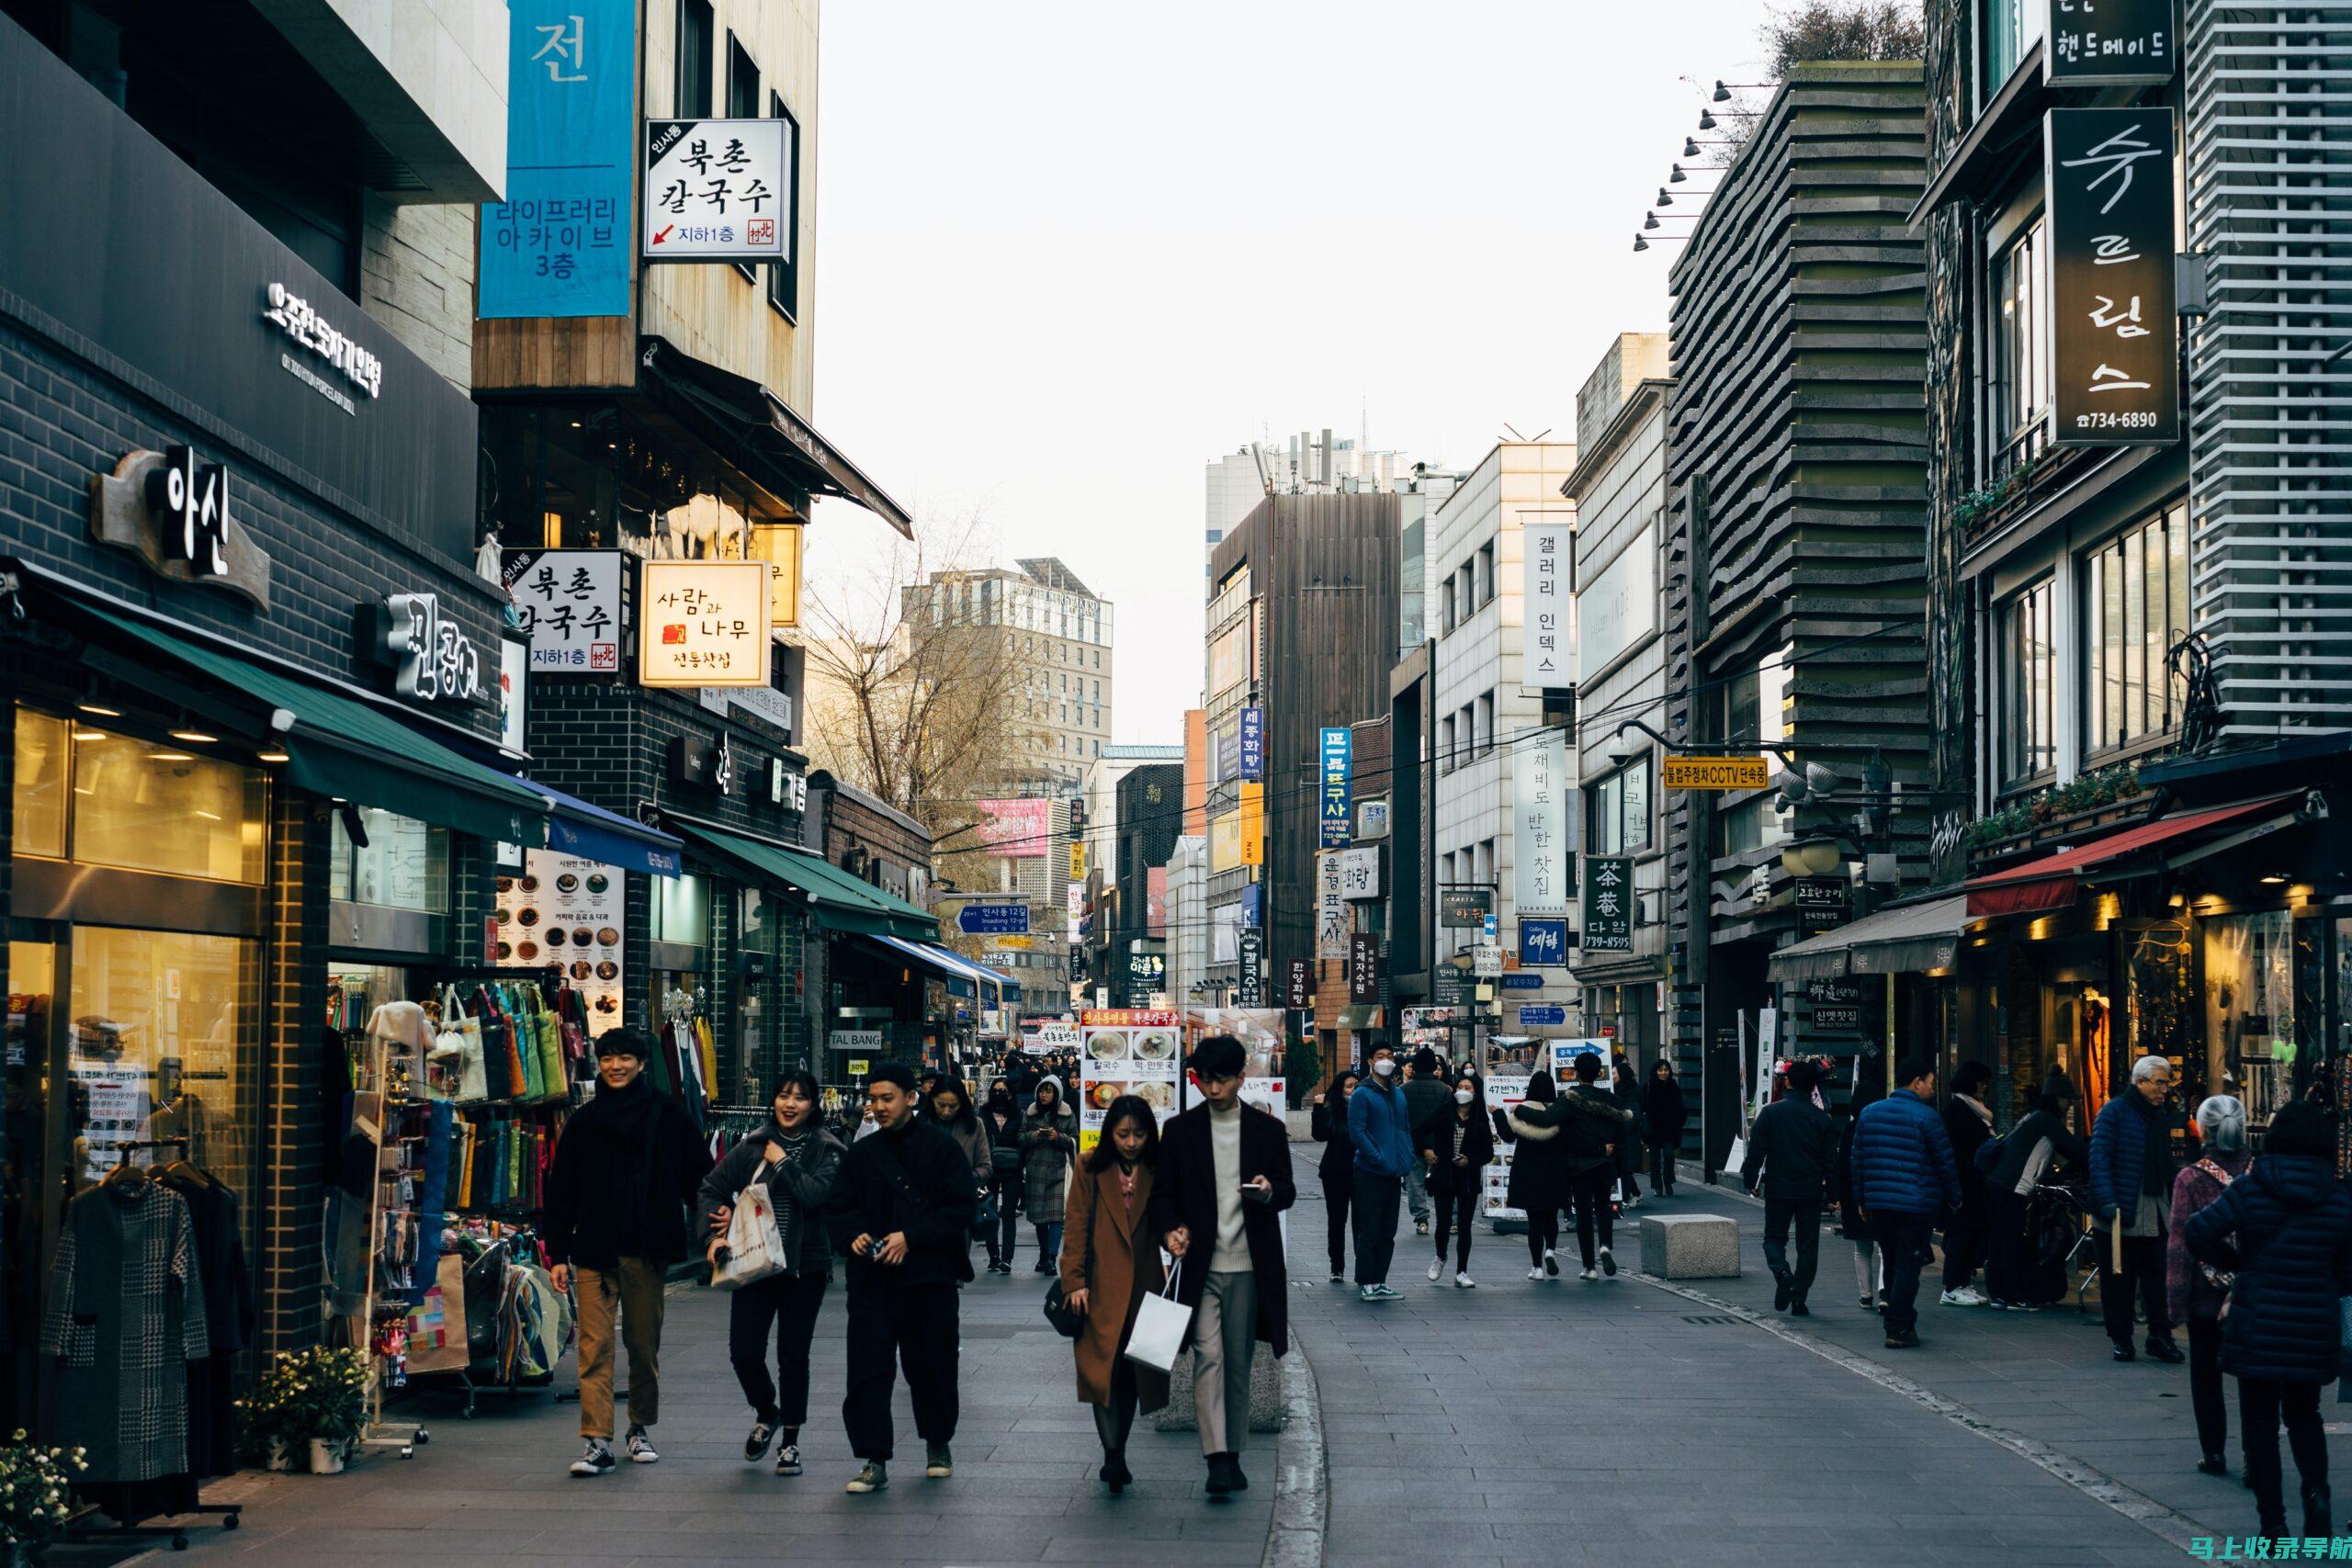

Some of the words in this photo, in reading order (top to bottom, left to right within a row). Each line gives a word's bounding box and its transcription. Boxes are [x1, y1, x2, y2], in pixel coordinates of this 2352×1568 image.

[530, 15, 588, 82] 전
[2058, 30, 2164, 62] 핸드메이드
[650, 124, 683, 155] 인사동
[679, 138, 752, 176] 북촌
[496, 197, 616, 225] 라이프러리
[658, 178, 773, 215] 칼국수
[497, 226, 615, 253] 아카이브
[536, 253, 575, 280] 3층
[2103, 412, 2157, 428] 734-6890
[1538, 536, 1555, 598] 갤러리
[529, 566, 596, 602] 북촌
[518, 604, 612, 640] 칼국수
[701, 621, 749, 639] 나무
[1537, 613, 1555, 672] 인덱스
[673, 651, 730, 669] 전통찻집
[1243, 711, 1260, 767] 세종화랑
[1529, 813, 1551, 848] 반한
[1533, 855, 1552, 897] 찻집
[555, 913, 574, 921] 커피와
[575, 913, 588, 921] 음료
[1589, 920, 1627, 934] 다암
[1243, 952, 1258, 988] 칼국수
[1293, 962, 1304, 1005] 한양화랑
[1355, 941, 1365, 994] 국제자수원
[1440, 968, 1459, 976] 인사동
[831, 1035, 849, 1045] TAL
[852, 1035, 880, 1045] BANG
[1488, 1085, 1520, 1094] 47번가
[1084, 1111, 1107, 1121] 사골우
